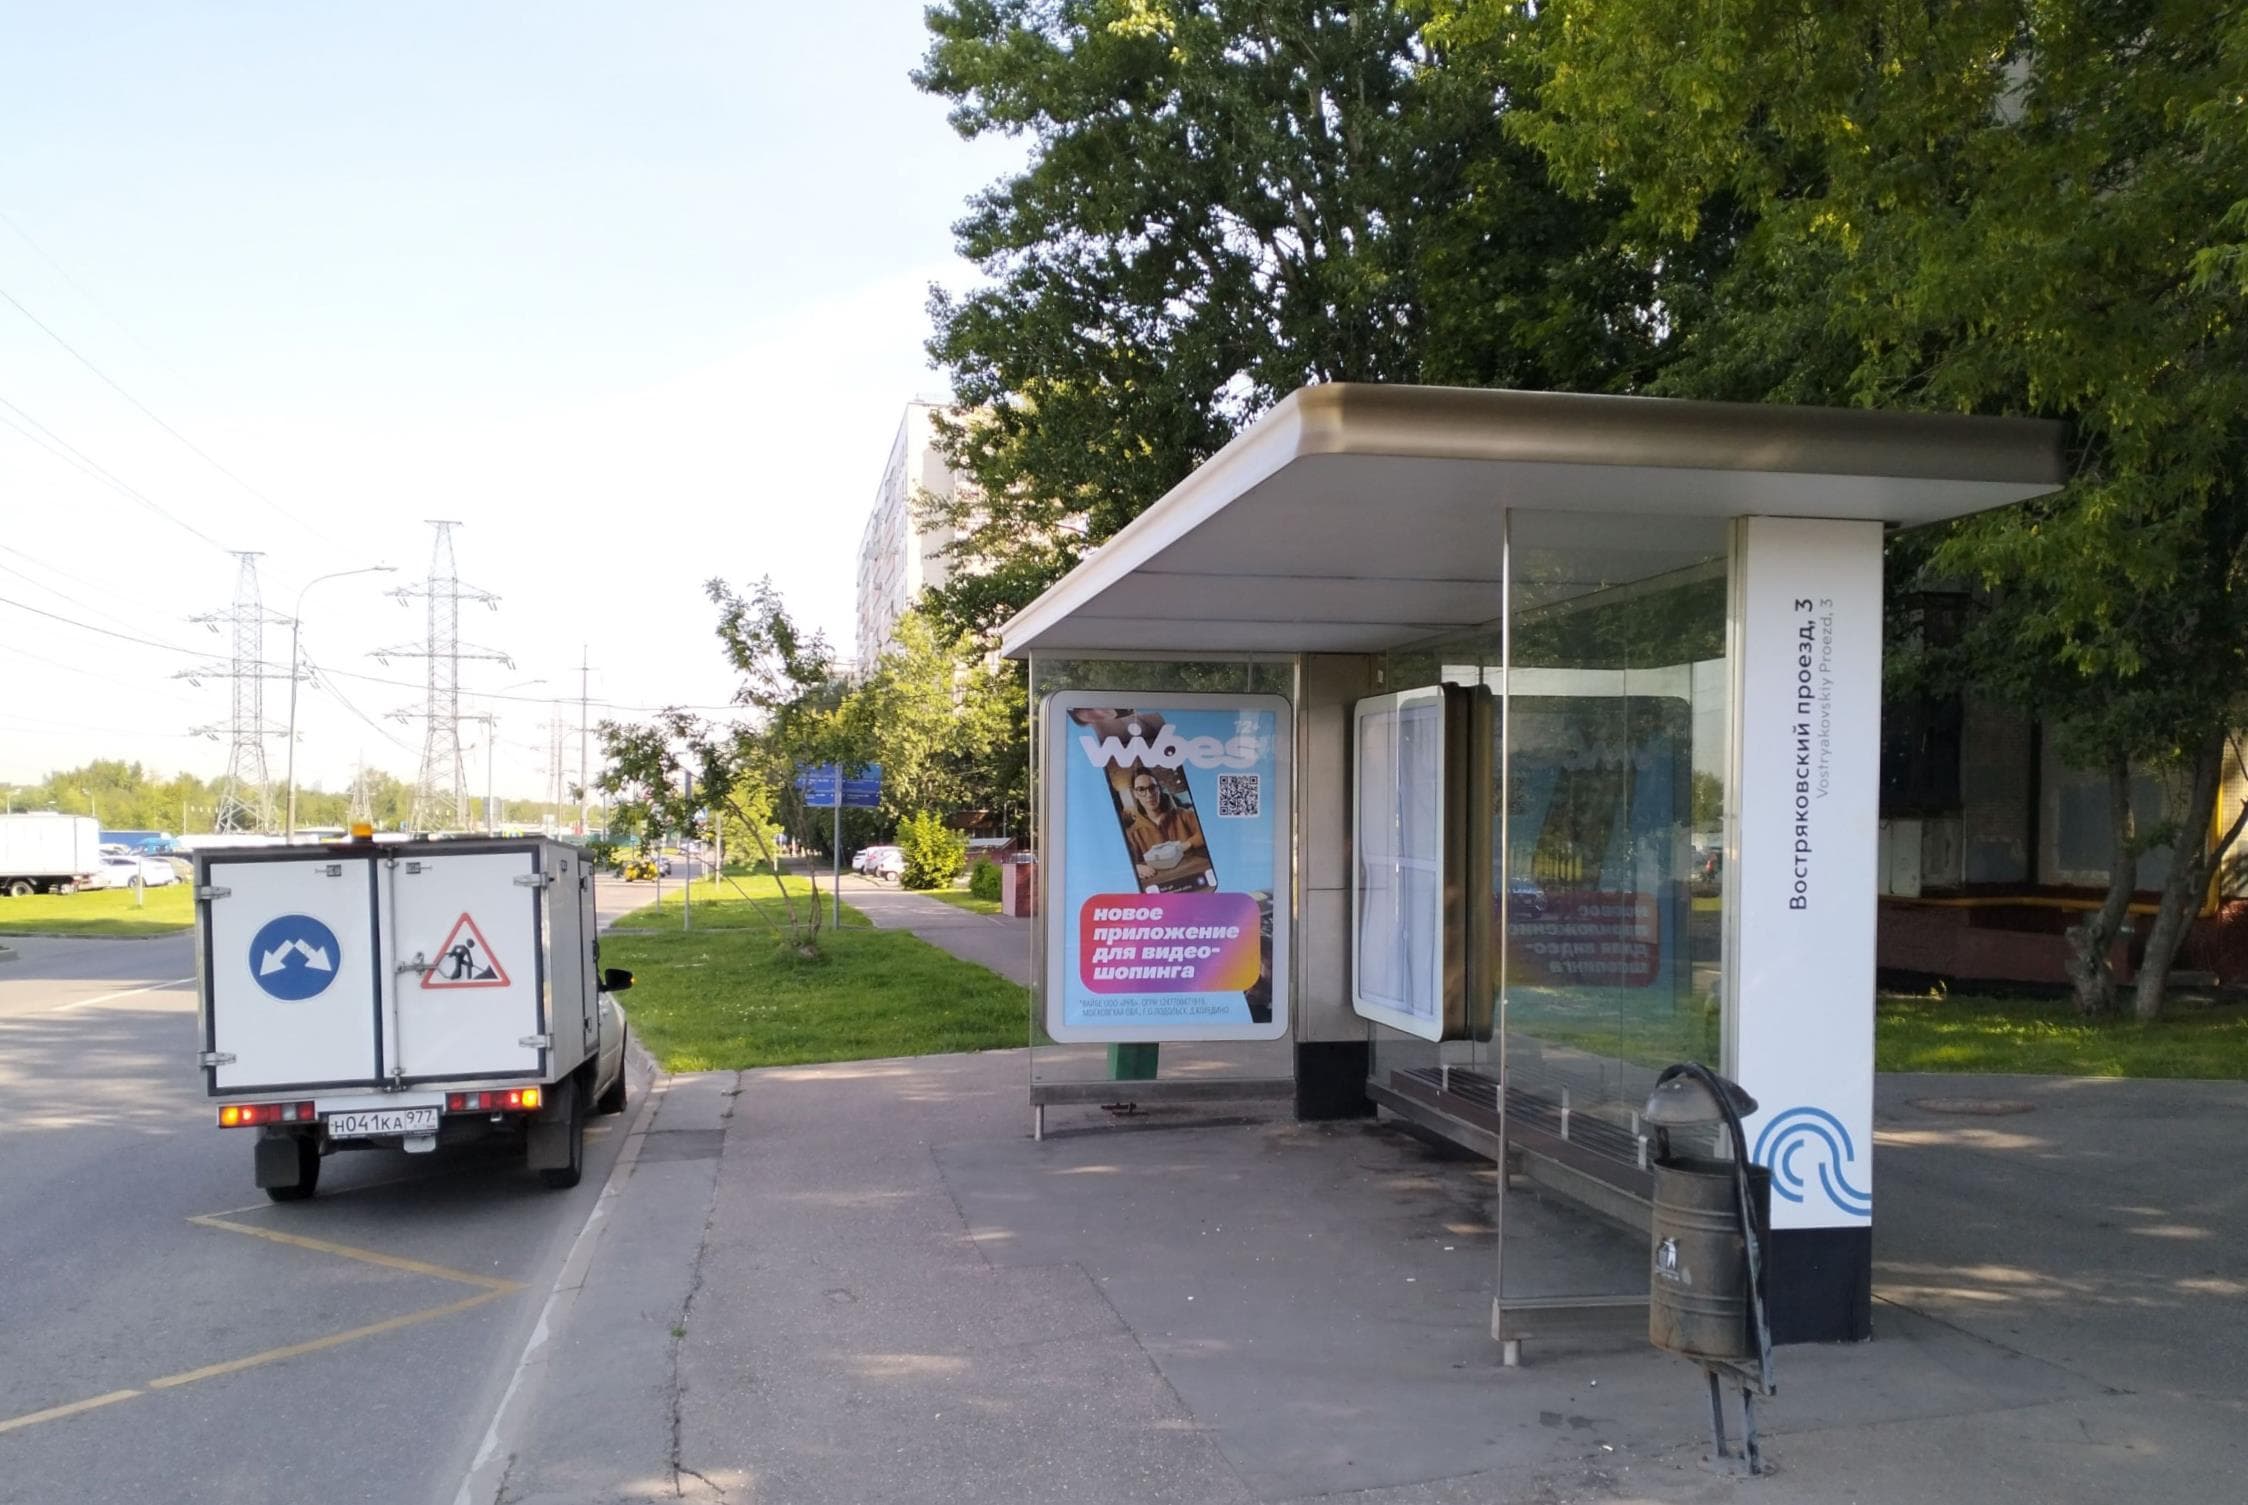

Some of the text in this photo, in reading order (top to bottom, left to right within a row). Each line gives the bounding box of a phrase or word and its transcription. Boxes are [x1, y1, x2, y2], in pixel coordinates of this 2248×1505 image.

[1816, 598, 1834, 799] Vostryakovskiy Proezd, 3
[1789, 598, 1816, 910] Востряковский проезд, 3
[1093, 907, 1164, 921] новое
[1093, 926, 1240, 945] приложение
[1092, 945, 1221, 963] для видео-
[1093, 965, 1196, 980] шопинга
[334, 1110, 432, 1133] Н041КА 977
